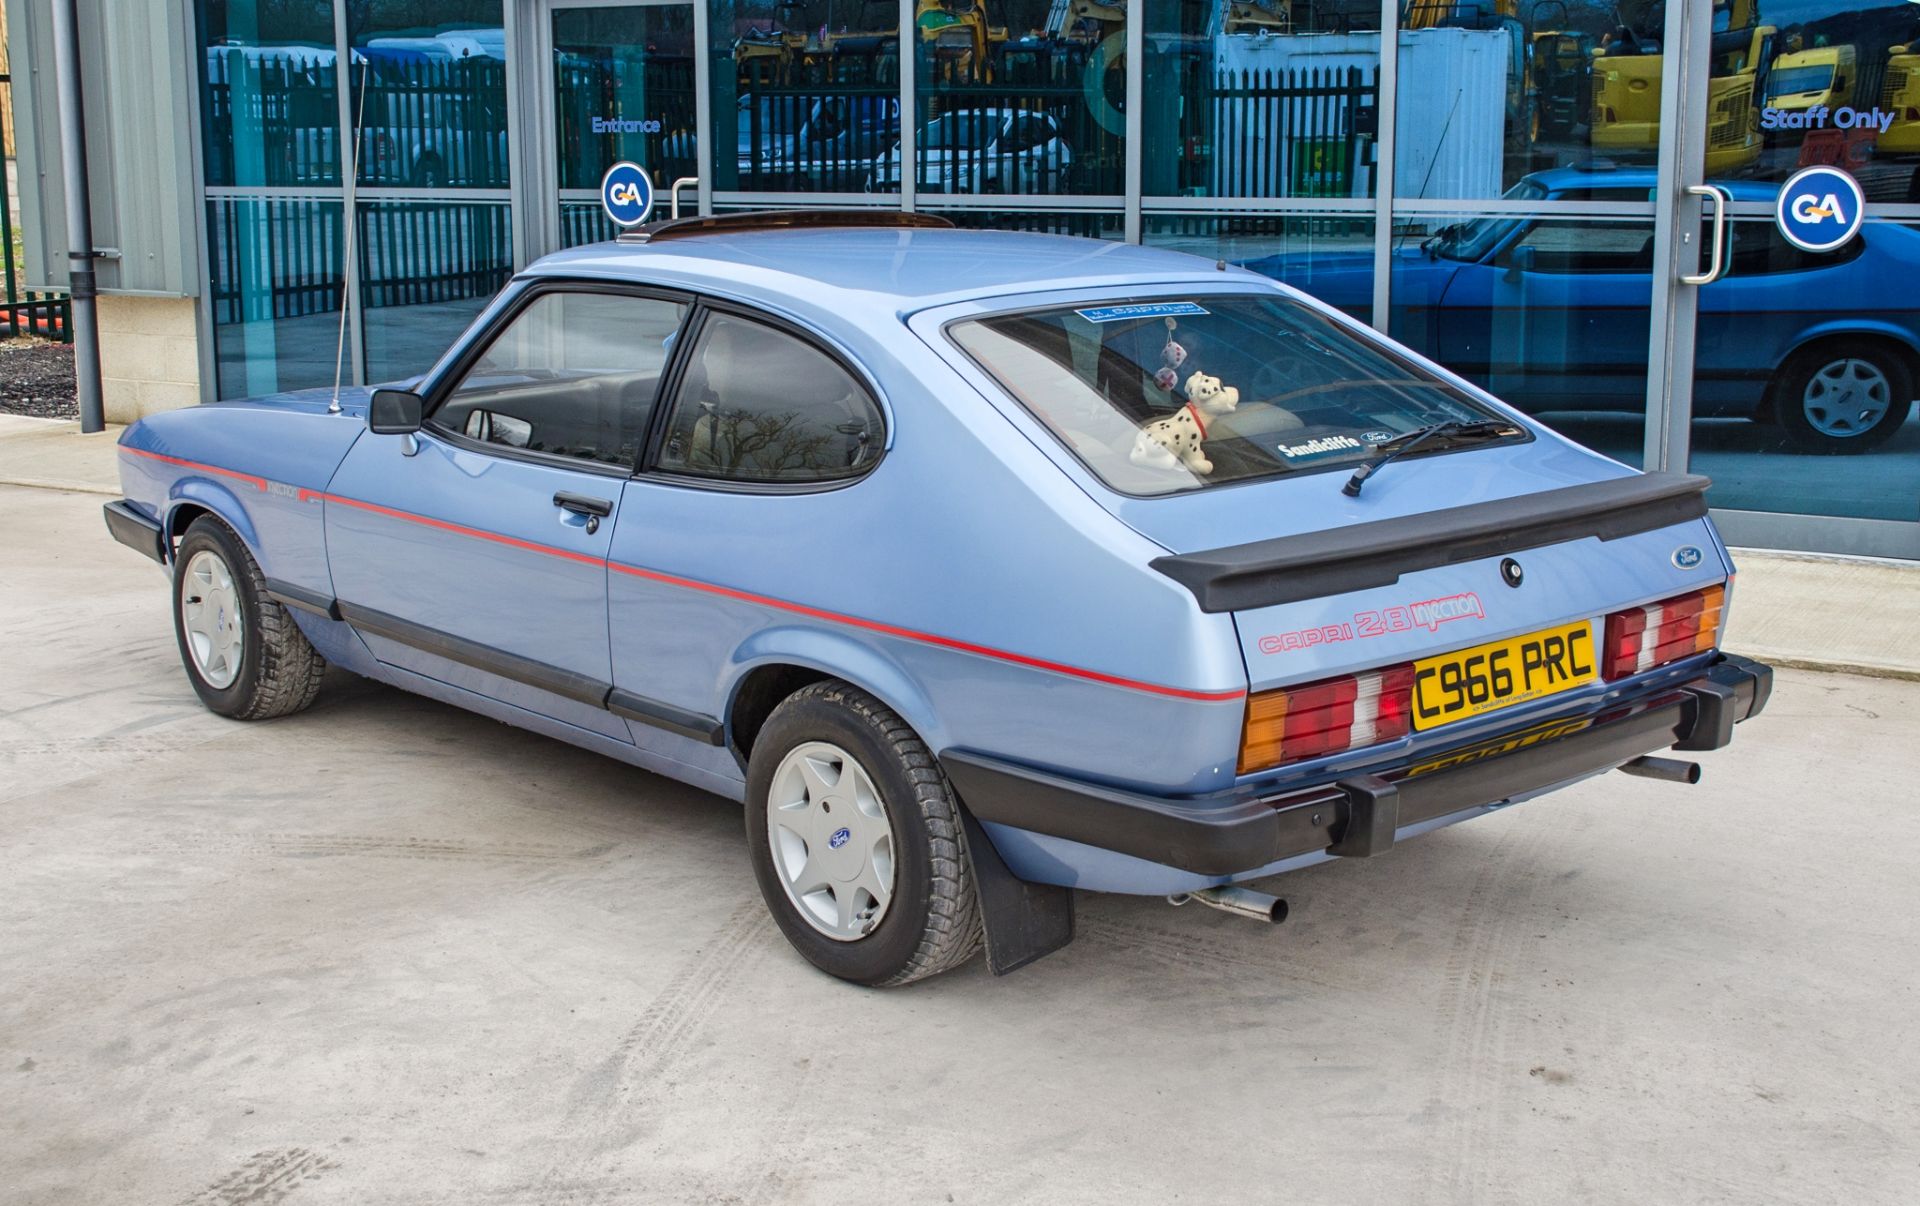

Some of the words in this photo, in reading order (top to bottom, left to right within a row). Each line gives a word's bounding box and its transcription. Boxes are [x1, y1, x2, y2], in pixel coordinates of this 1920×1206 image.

[591, 116, 661, 134] Entrance
[1760, 105, 1829, 129] Staff
[1834, 106, 1895, 133] Only
[610, 182, 644, 207] GA
[1791, 193, 1847, 225] GA
[1277, 434, 1361, 458] Sandicliffe
[1258, 623, 1354, 655] CAPRI
[1415, 648, 1514, 719] C966
[1521, 628, 1592, 691] PRC
